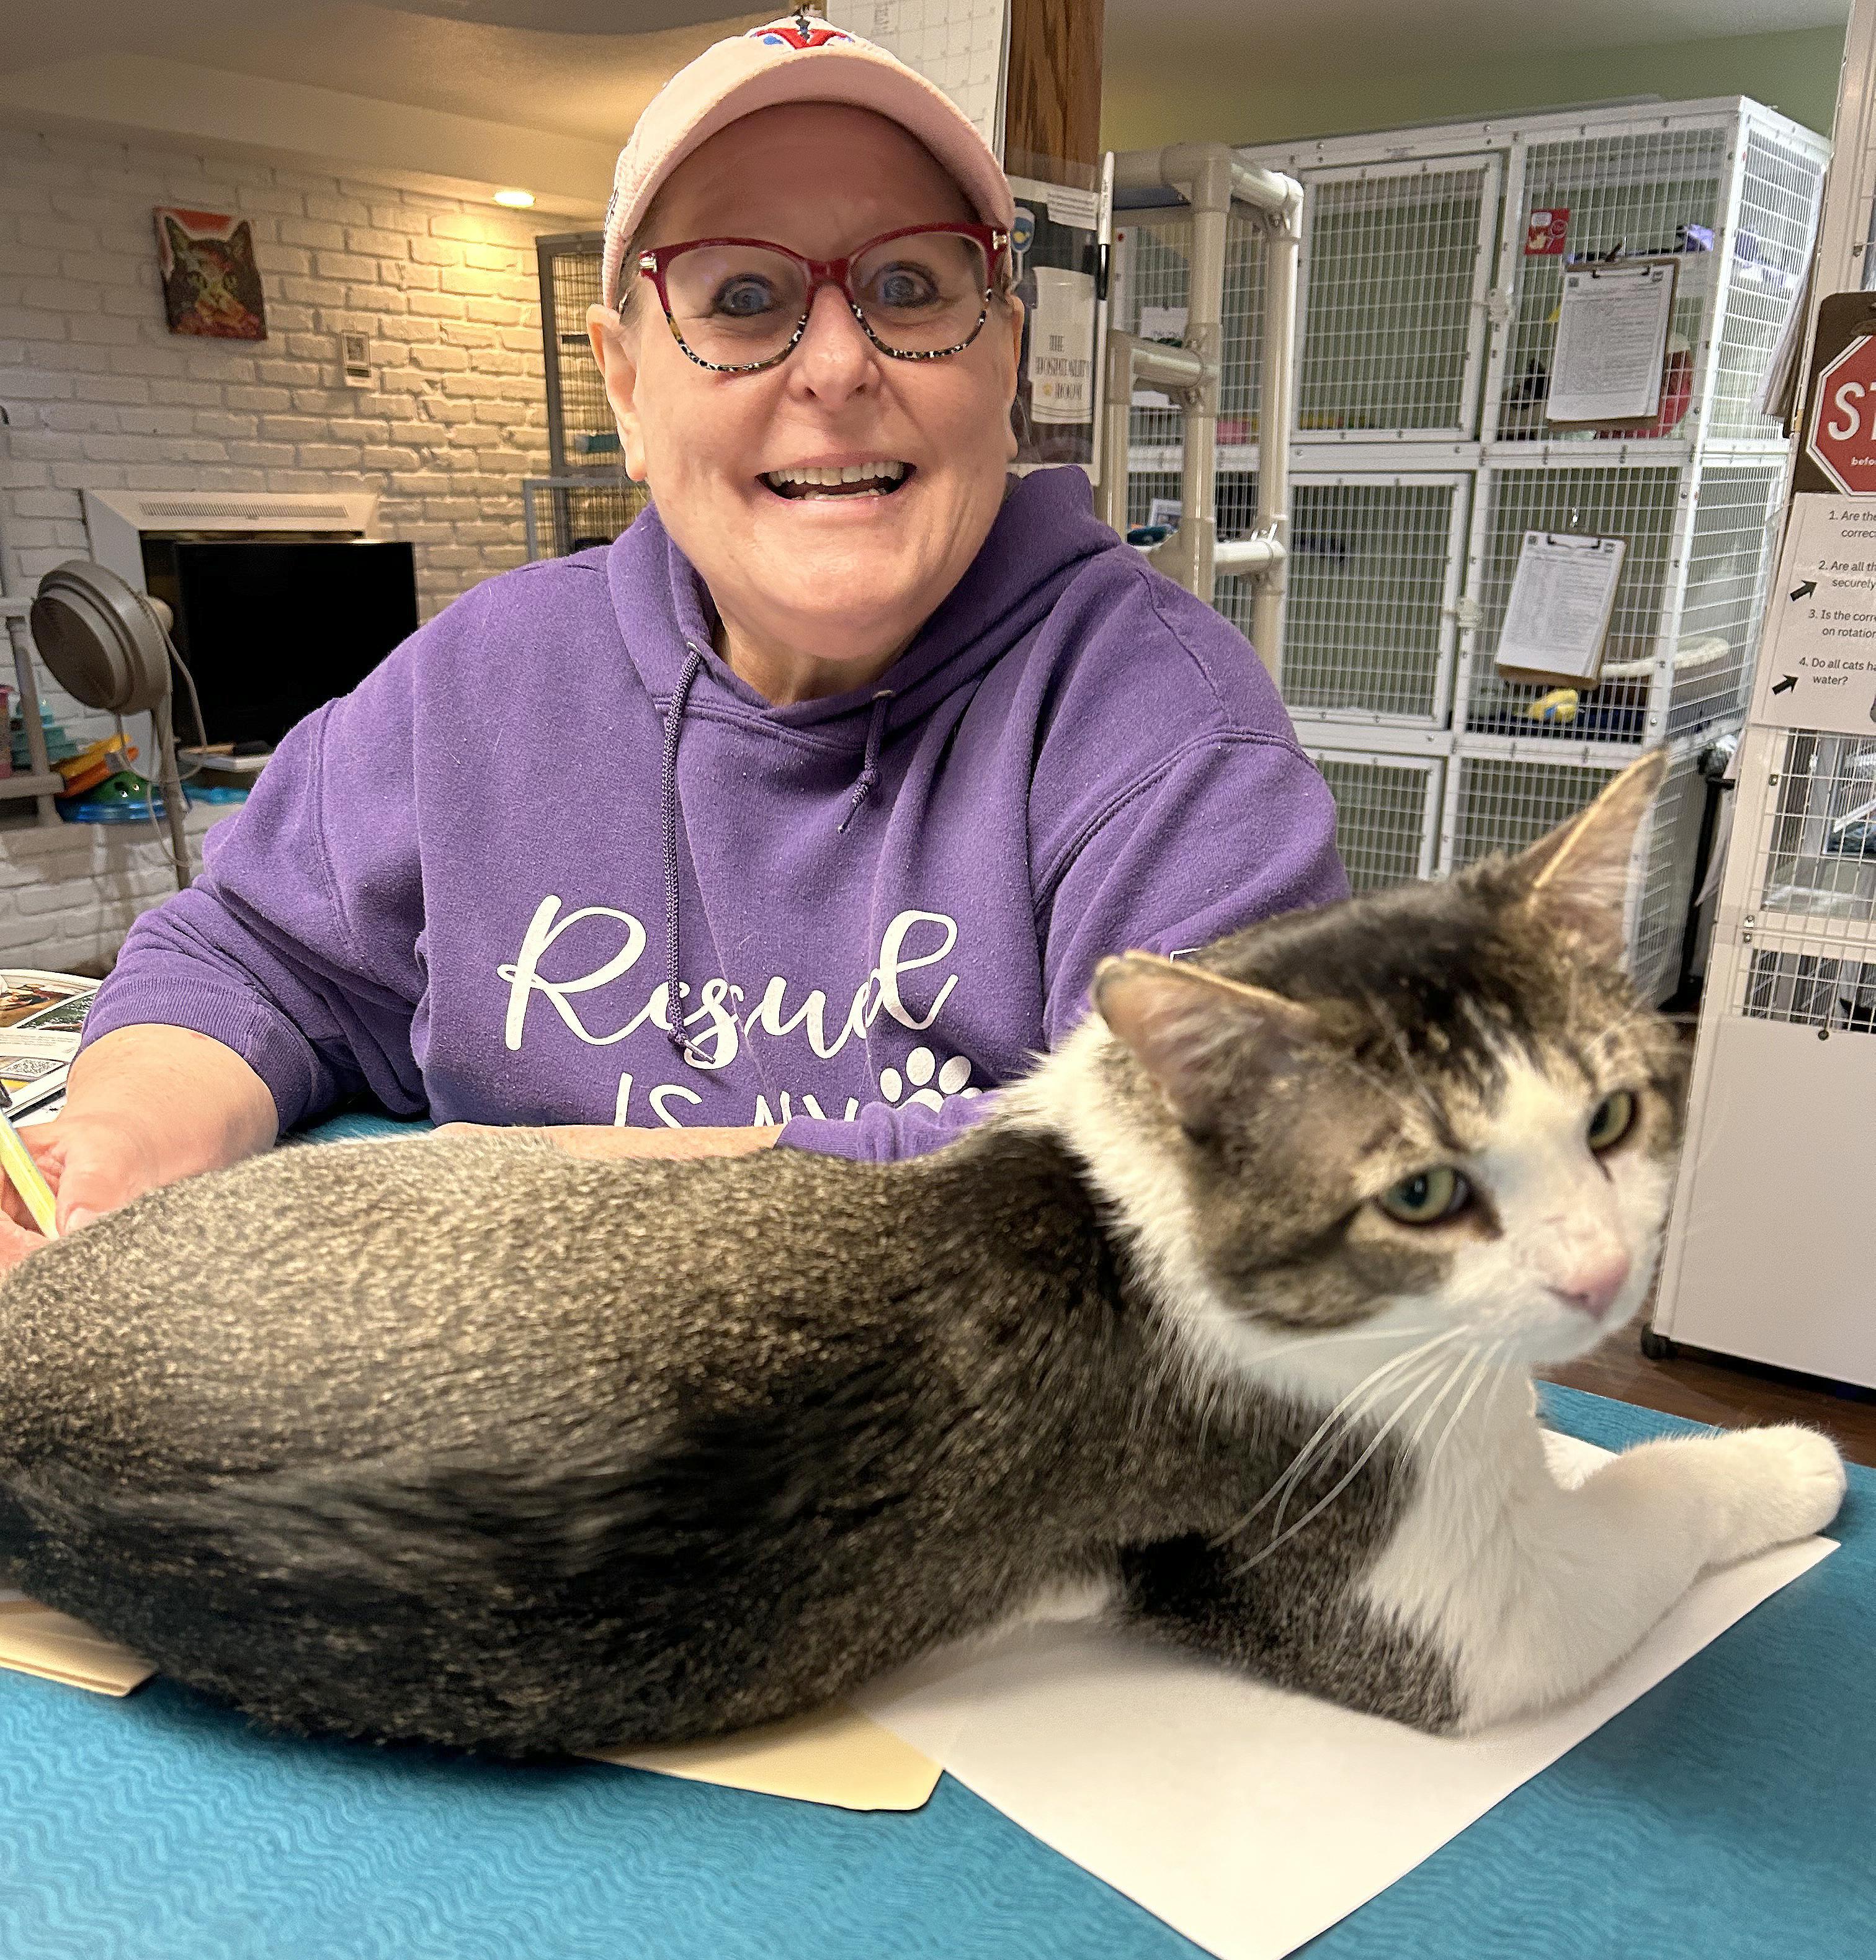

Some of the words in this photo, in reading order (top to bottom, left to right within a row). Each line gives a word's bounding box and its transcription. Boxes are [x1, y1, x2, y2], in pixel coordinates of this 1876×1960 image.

[1828, 381, 1876, 441] S
[1851, 456, 1876, 466] befo
[1829, 510, 1838, 521] 1.
[1841, 510, 1860, 521] Are
[1841, 529, 1876, 538] correc
[1818, 560, 1828, 570] 2.
[1831, 560, 1849, 571] Are
[1851, 561, 1865, 571] all
[1832, 579, 1876, 591] securely
[1808, 609, 1818, 619] 3.
[1821, 609, 1831, 620] Is
[1834, 611, 1851, 621] the
[1822, 627, 1835, 636] on
[1798, 656, 1808, 667] 4.
[1811, 658, 1826, 668] Do
[1828, 659, 1841, 669] all
[1842, 661, 1864, 671] cats
[1813, 674, 1849, 686] water?
